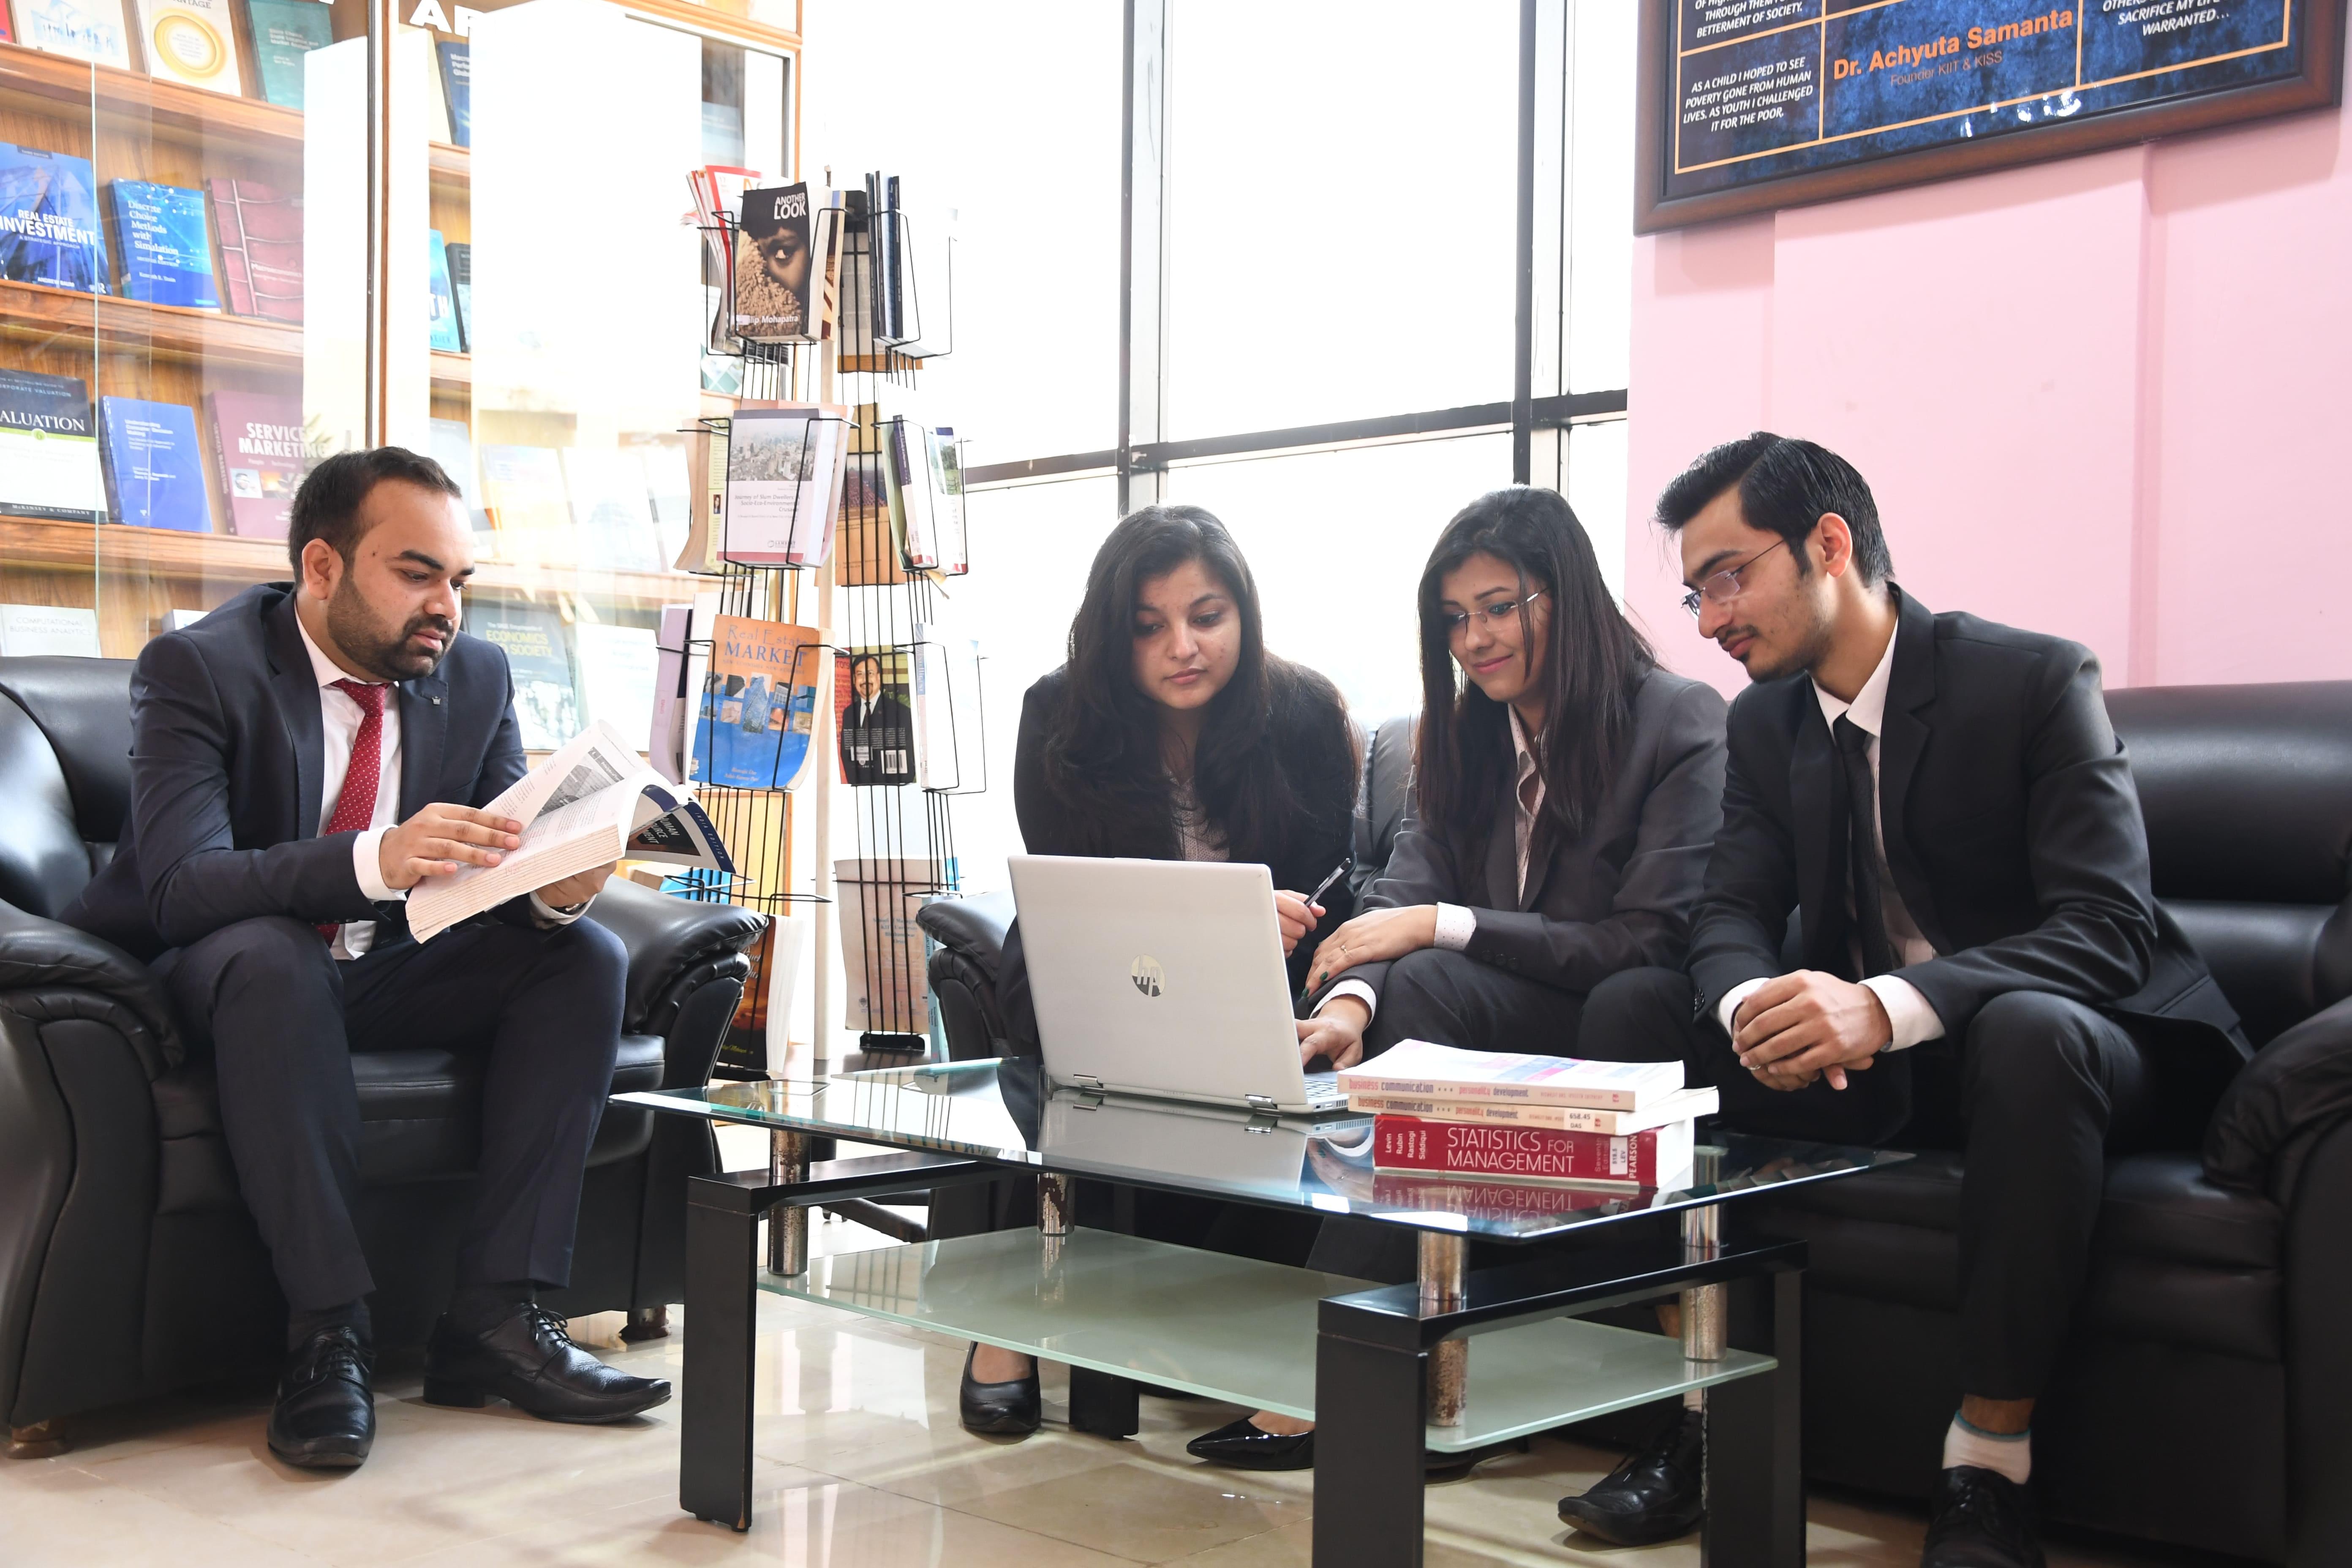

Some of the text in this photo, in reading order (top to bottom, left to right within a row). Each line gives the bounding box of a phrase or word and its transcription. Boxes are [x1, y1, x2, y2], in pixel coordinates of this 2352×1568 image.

[1696, 1, 1802, 38] BETTERMENT OF SOCIETY.
[1705, 2, 1746, 22] THROUGH
[2118, 0, 2192, 25] SACRIFICE MY
[2142, 8, 2230, 36] WARRANTED...
[1834, 9, 2073, 80] Dr. Achyuta Samanta
[1691, 56, 1806, 93] AS A CHILD I HOPED TO SEE
[1891, 50, 2003, 86] Founder KIIT & KISS
[1685, 70, 1811, 109] POVERTY GONE FROM HUMAN
[1683, 85, 1813, 124] LIVES. AS YOUTH I CHALLENGED
[1711, 106, 1784, 132] IT FOR THE POOR.
[128, 200, 162, 214] Discrete
[774, 201, 806, 220] LOOK
[775, 192, 805, 205] ANOTHER
[18, 209, 74, 228] REAL ESTATE
[129, 210, 158, 223] Choice
[131, 220, 167, 234] Methods
[0, 215, 95, 246] INVESTMENT
[134, 241, 178, 255] Simulation
[761, 315, 798, 325] Mohapatra
[0, 409, 85, 432] ALUATION
[238, 437, 329, 459] MARKETING
[486, 629, 548, 645] ECONOMICS
[728, 625, 758, 640] Real
[510, 643, 553, 656] SOCIETY
[725, 641, 808, 666] MARKET
[694, 812, 725, 859] INDIA EDITION
[1134, 954, 1163, 997] hp
[1349, 1078, 1378, 1091] business
[1381, 1081, 1434, 1093] communication
[1459, 1086, 1490, 1096] personality
[1358, 1097, 1384, 1109] business
[1386, 1100, 1433, 1113] communication
[1456, 1106, 1484, 1117] personality
[1407, 1131, 1416, 1158] Rastogi
[1418, 1130, 1426, 1160] Siddiqui
[1448, 1127, 1574, 1153] STATISTICS FOR
[1448, 1149, 1574, 1173] MANAGEMENT
[1628, 1135, 1638, 1179] PEARSON
